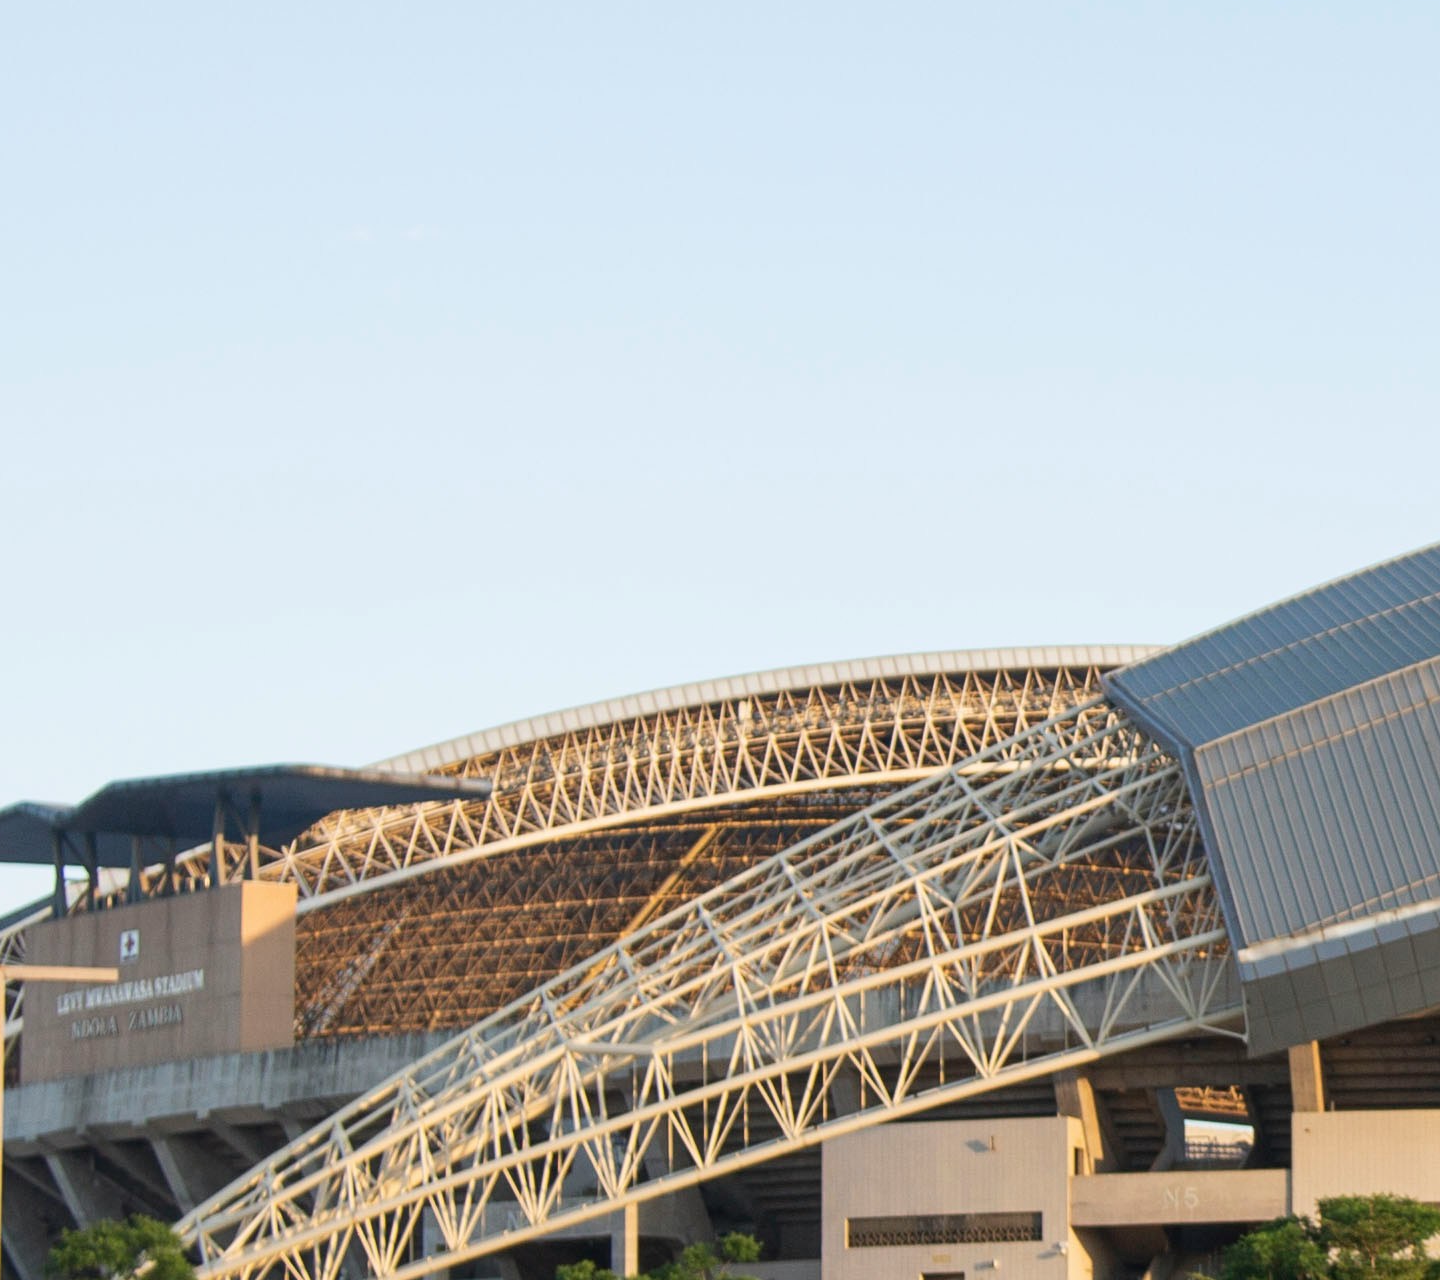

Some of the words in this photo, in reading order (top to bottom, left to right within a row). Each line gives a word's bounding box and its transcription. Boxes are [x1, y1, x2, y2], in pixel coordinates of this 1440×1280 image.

[154, 969, 204, 996] STADIUM
[72, 1016, 119, 1039] NDOLA
[128, 1004, 183, 1031] ZAMBIA
